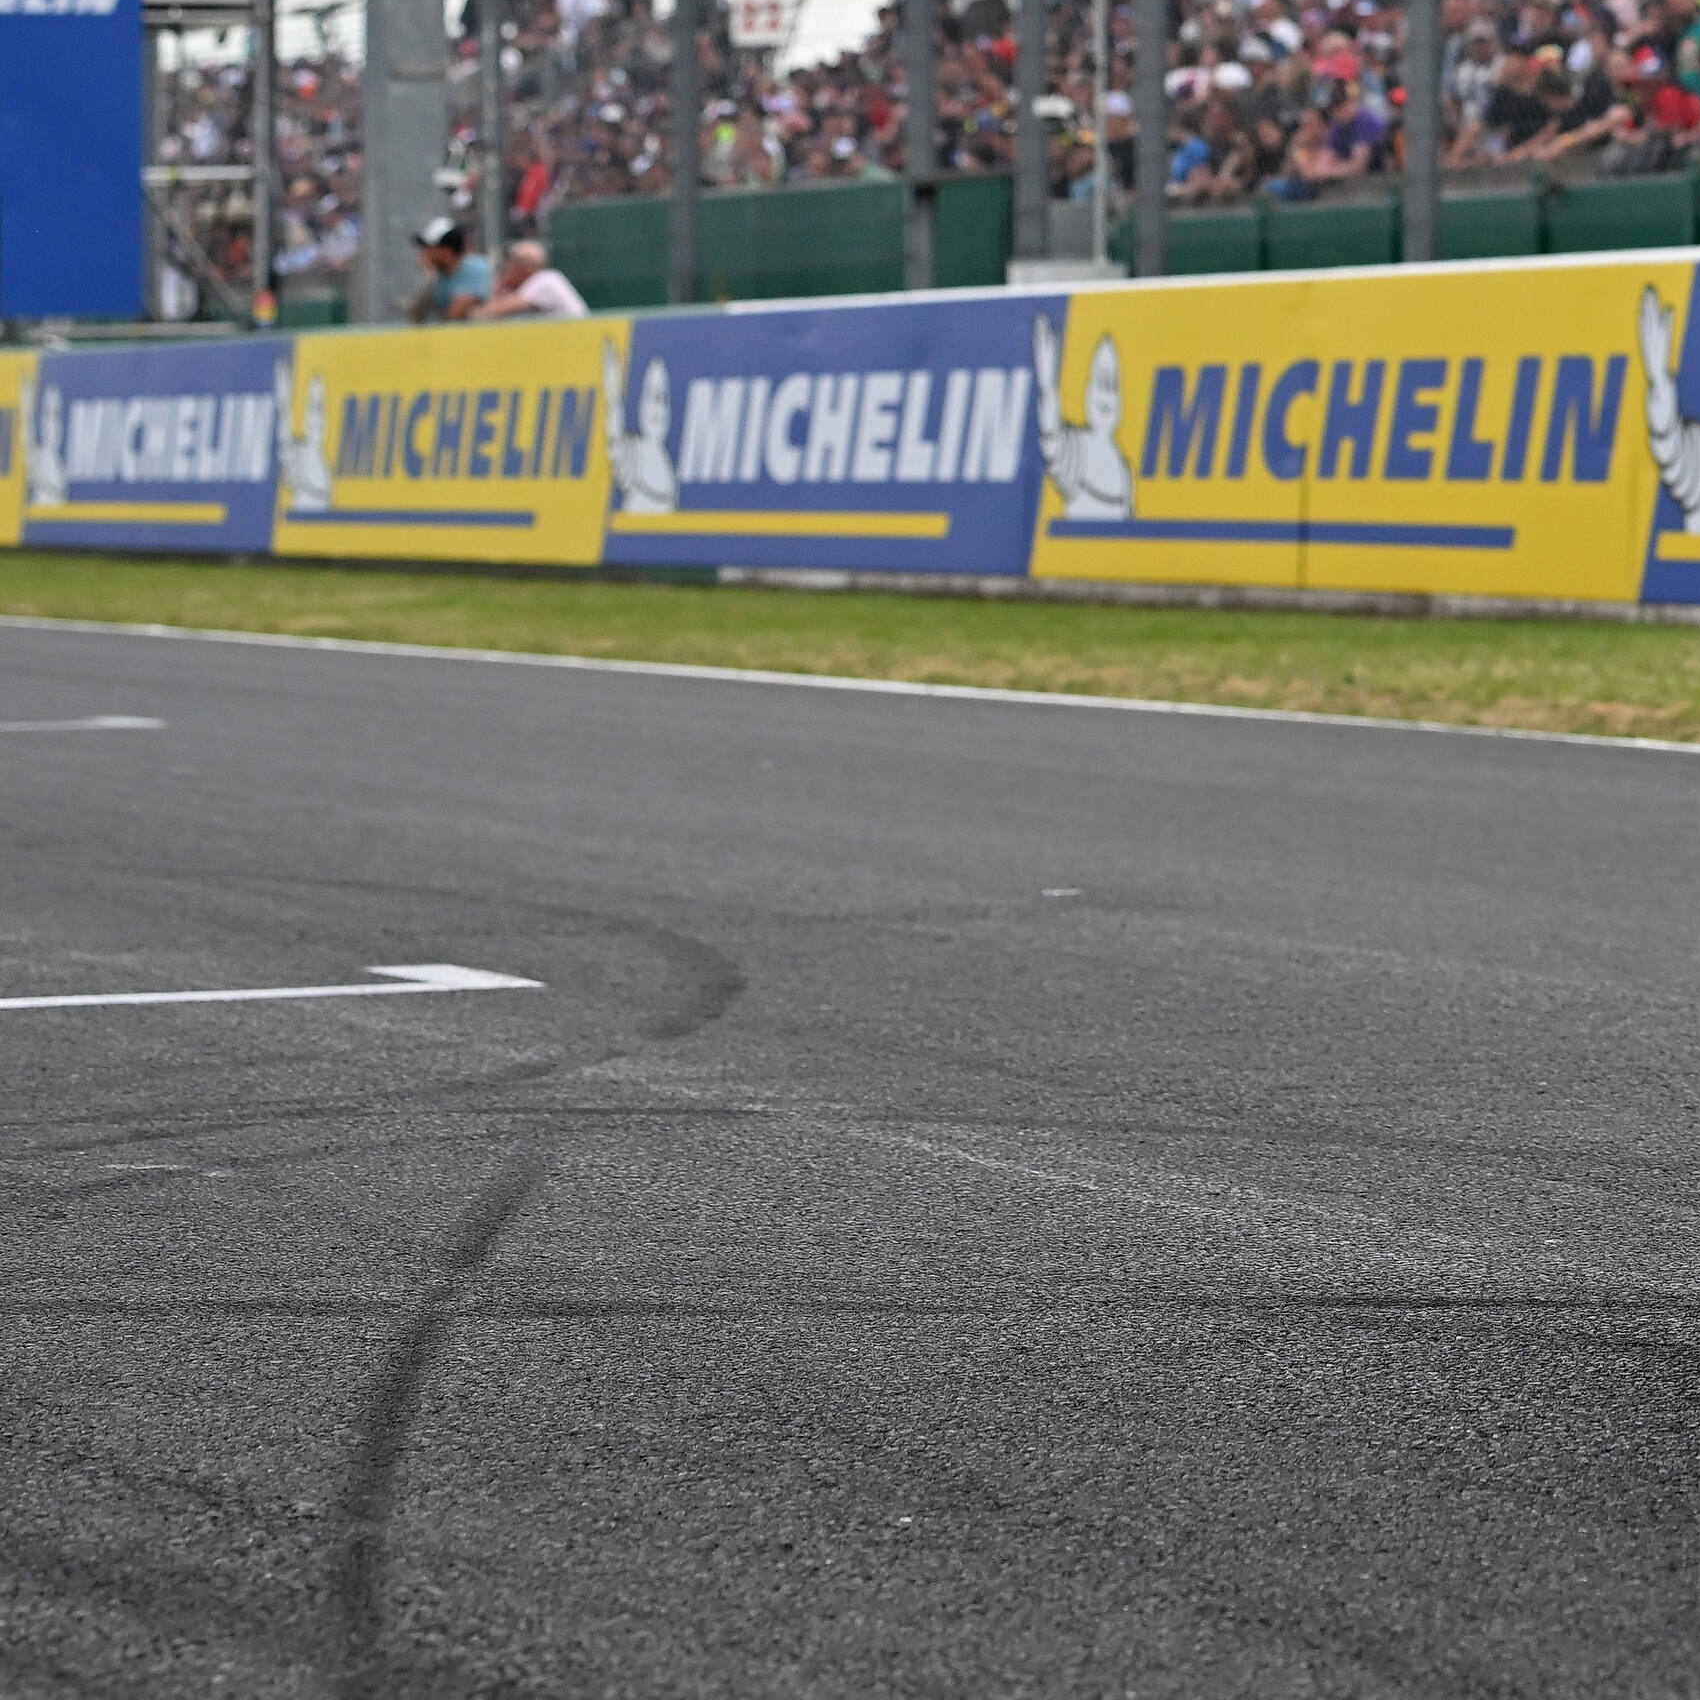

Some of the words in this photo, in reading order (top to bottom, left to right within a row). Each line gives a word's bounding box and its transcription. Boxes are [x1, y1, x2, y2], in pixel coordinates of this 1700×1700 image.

[65, 392, 277, 483] MICHELIN
[335, 386, 597, 479] MICHELIN
[678, 367, 1033, 484] MICHELIN
[1140, 354, 1629, 484] MICHELIN
